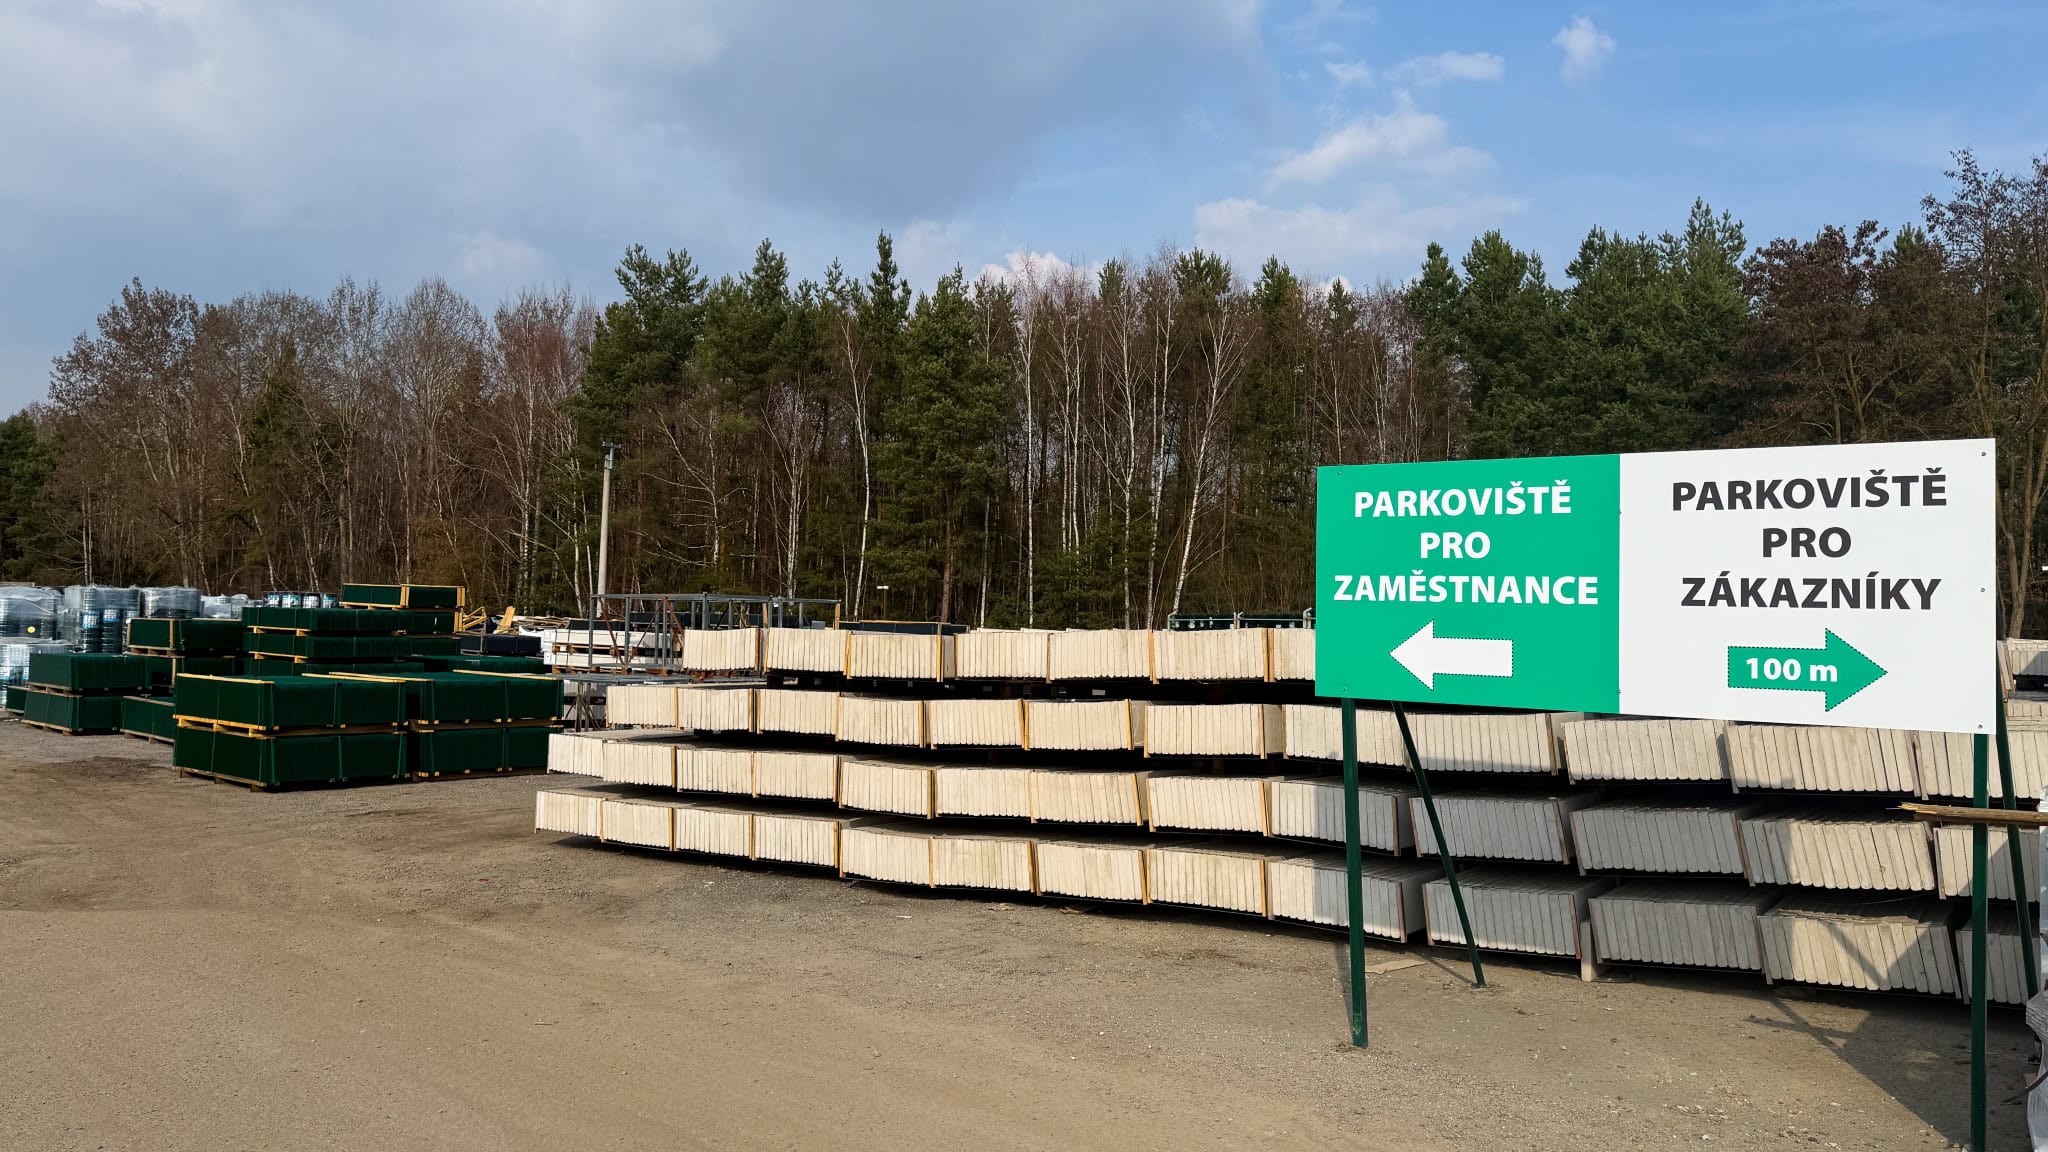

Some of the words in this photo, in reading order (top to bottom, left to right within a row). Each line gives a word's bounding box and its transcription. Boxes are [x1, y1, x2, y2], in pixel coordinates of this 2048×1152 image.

[1354, 480, 1572, 518] PARKOVIŠTĚ
[1672, 466, 1947, 512] PARKOVIŠTĚ
[1420, 531, 1491, 559] PRO
[1762, 526, 1852, 558] PRO
[1333, 569, 1599, 605] ZAMĚSTNANCE
[1680, 570, 1942, 610] ZÁKAZNÍKY
[1746, 657, 1802, 681] 100
[1809, 664, 1838, 683] m
